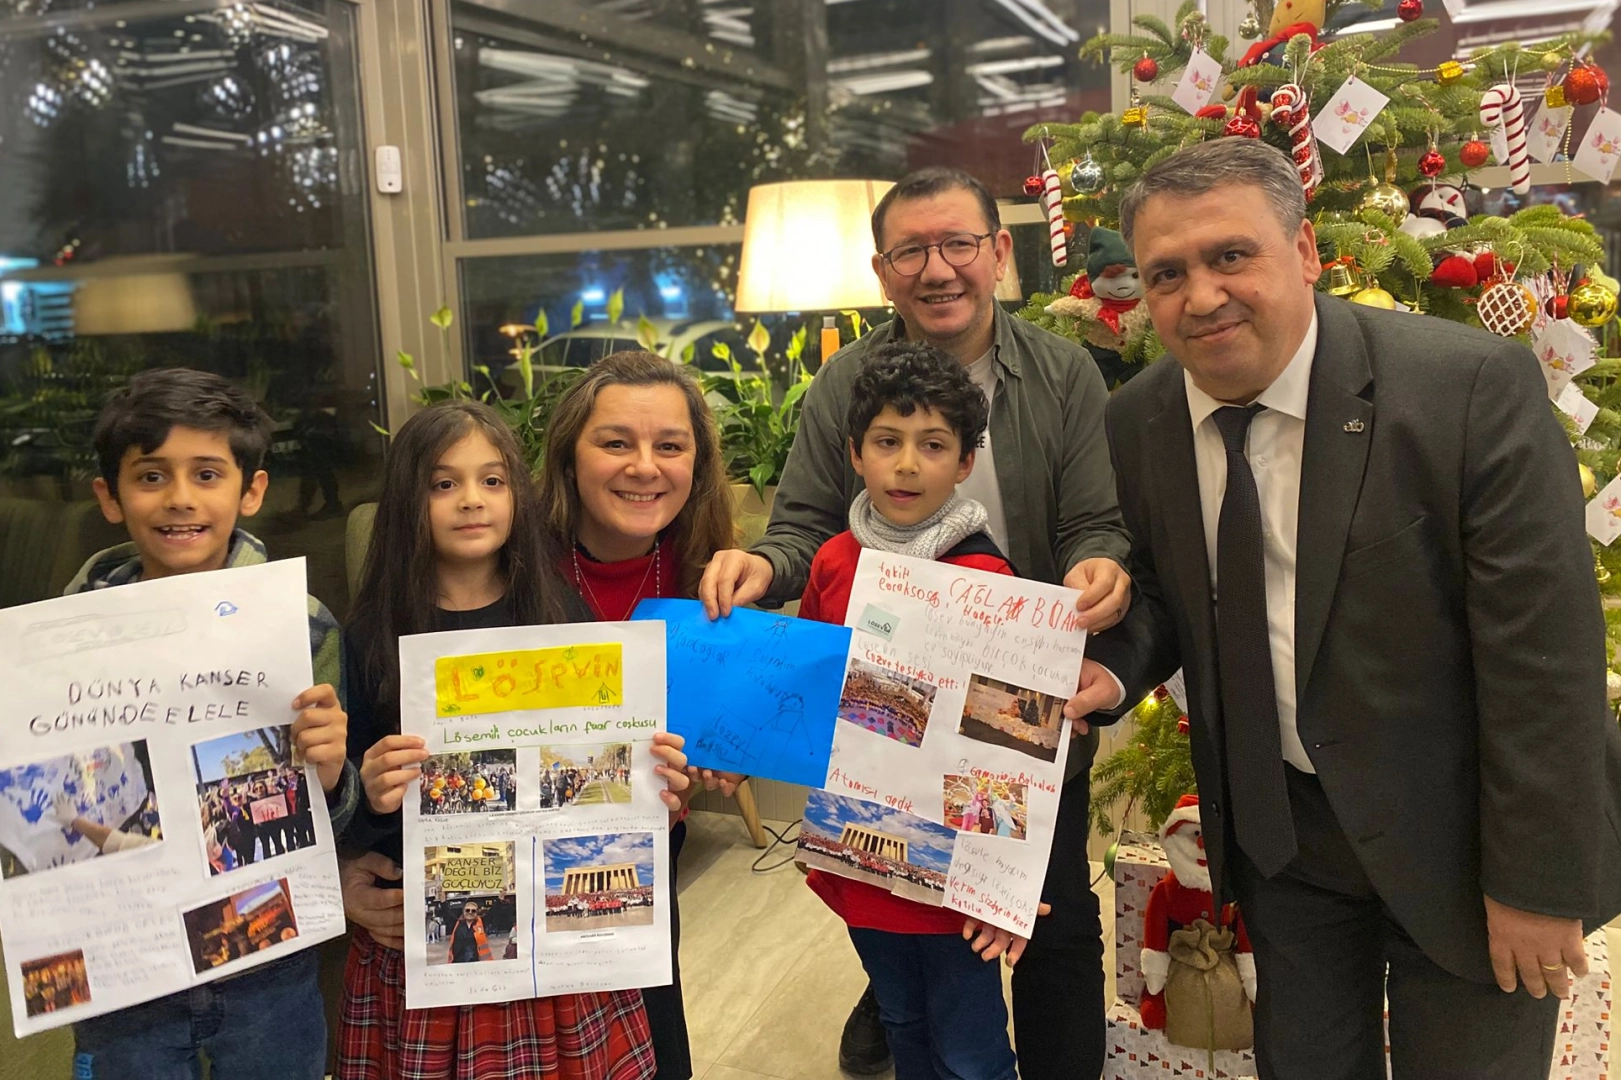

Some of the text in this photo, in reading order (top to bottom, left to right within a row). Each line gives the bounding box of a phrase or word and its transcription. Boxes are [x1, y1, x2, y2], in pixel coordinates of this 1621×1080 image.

[180, 670, 269, 691] KANSER
[447, 858, 496, 868] KANSER
[483, 865, 502, 876] BİZ
[441, 878, 503, 890] GÜÇLÜYÜZ
